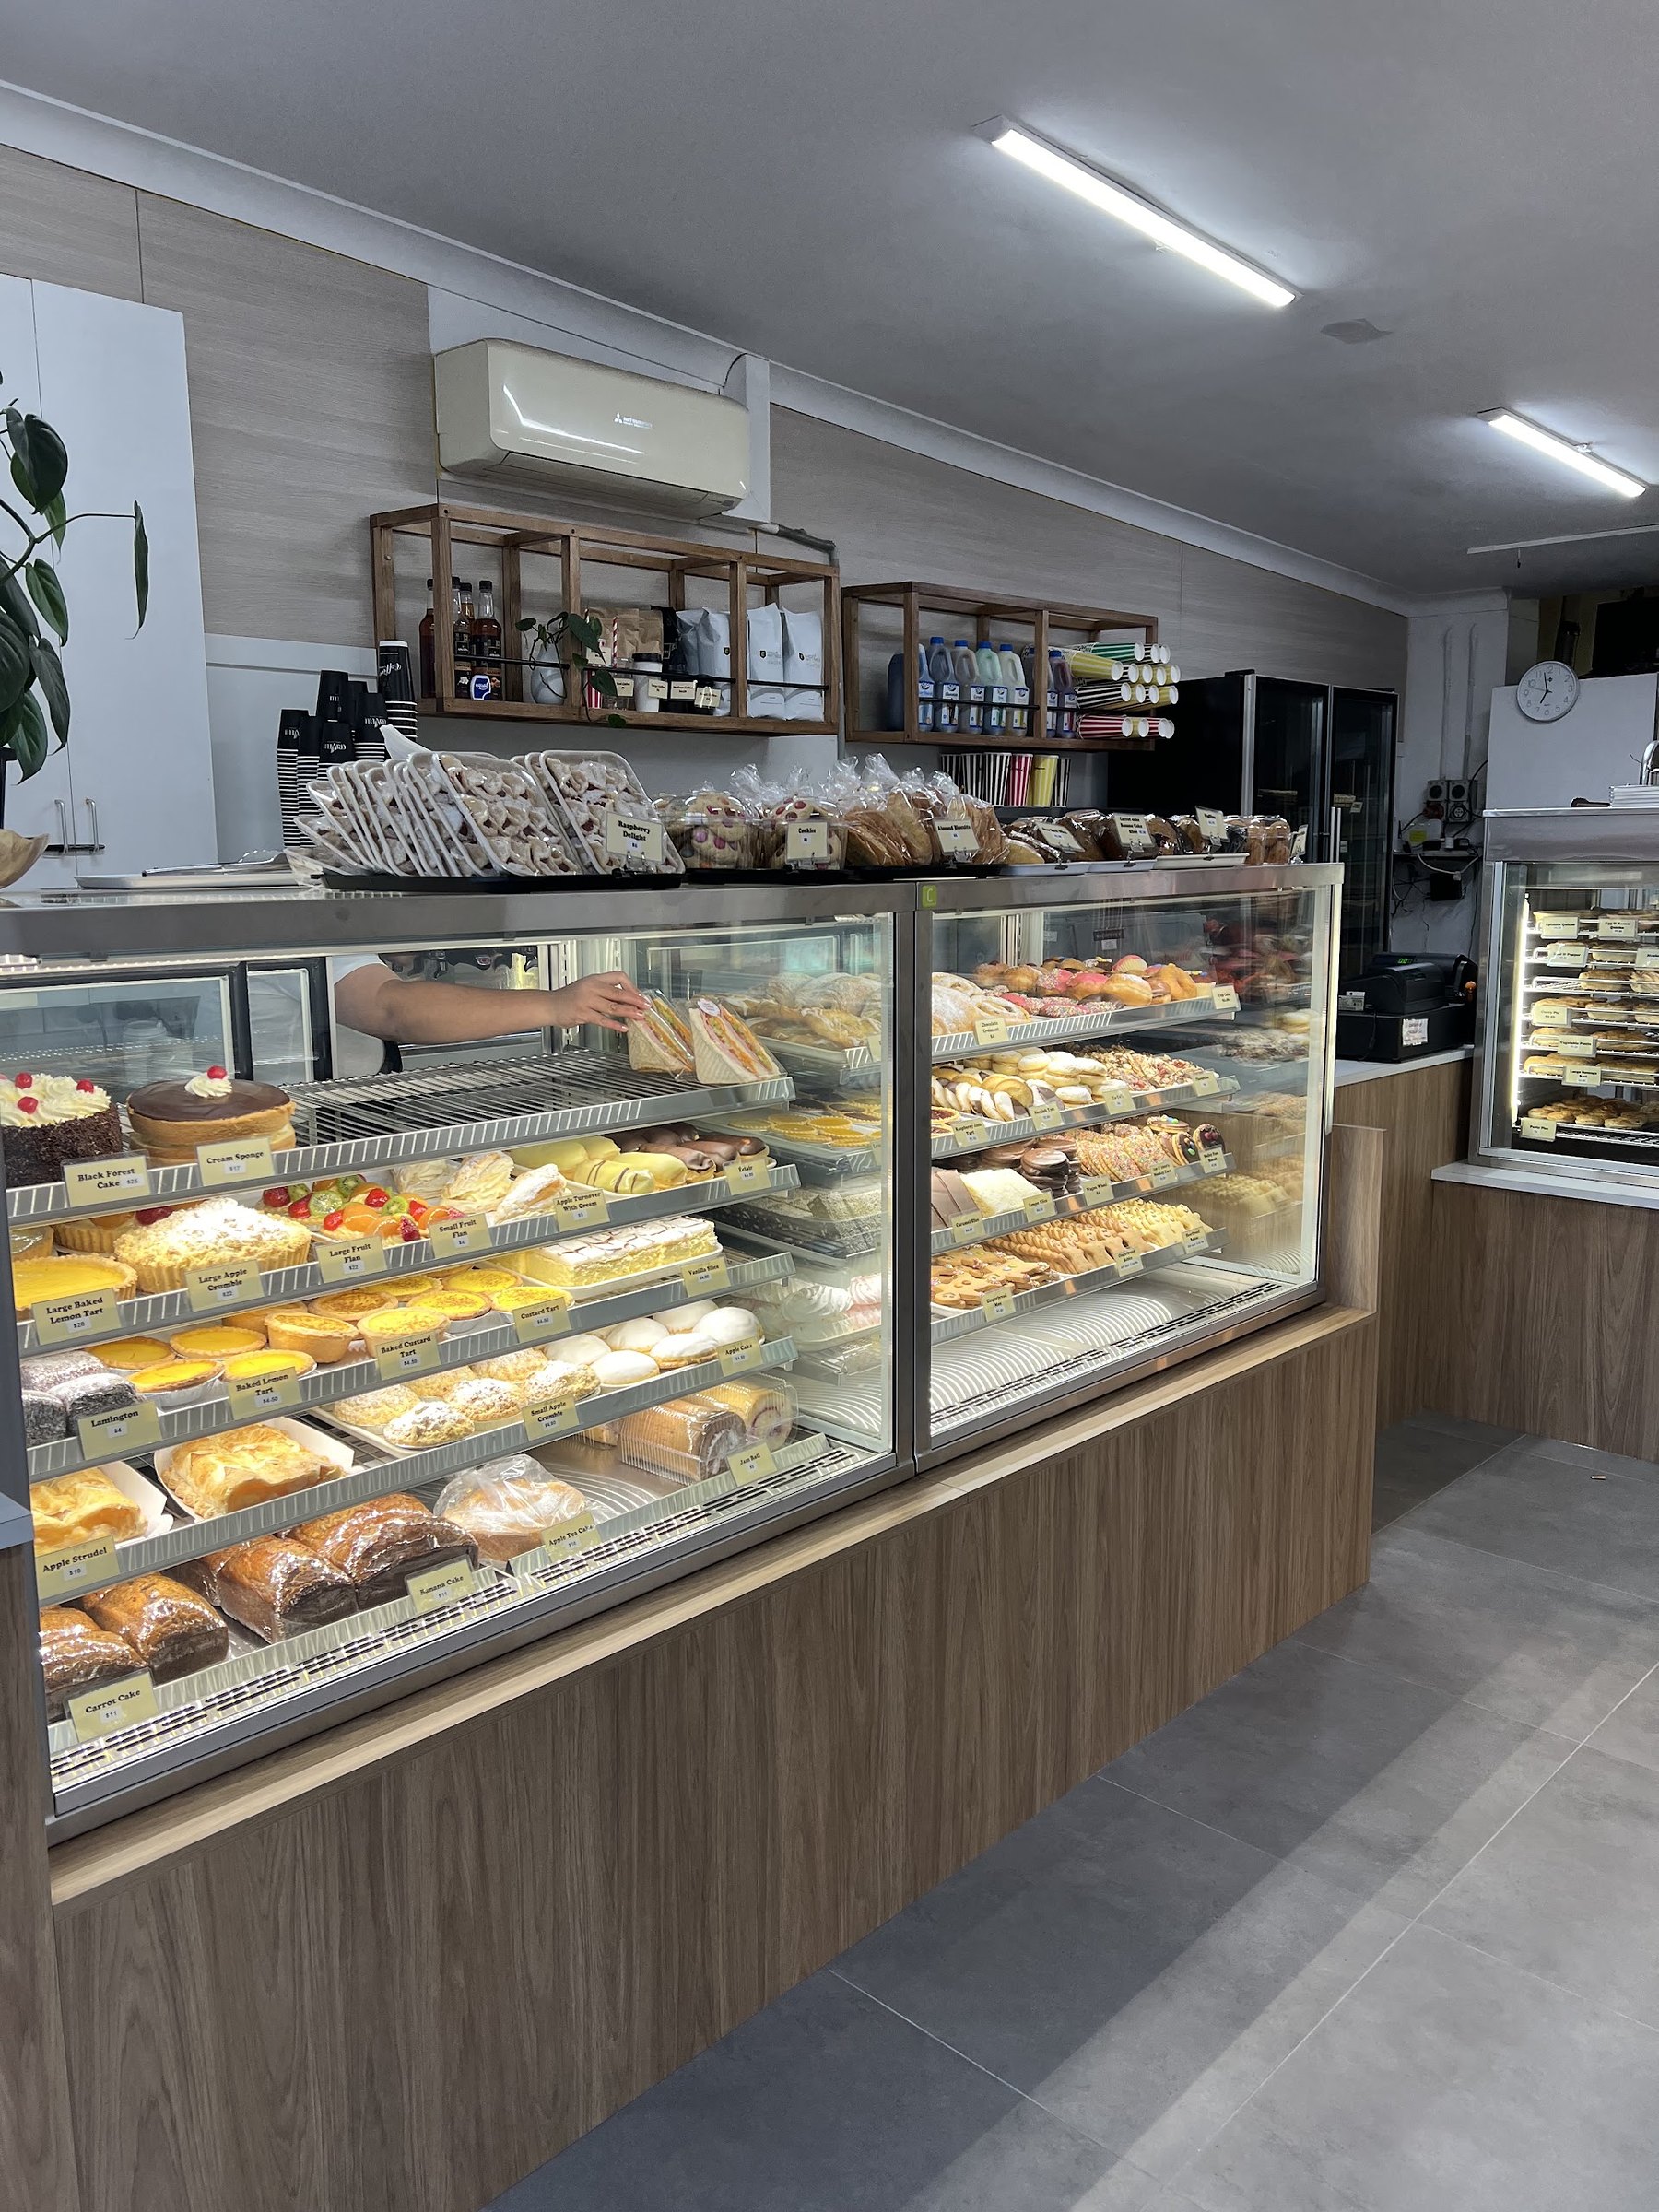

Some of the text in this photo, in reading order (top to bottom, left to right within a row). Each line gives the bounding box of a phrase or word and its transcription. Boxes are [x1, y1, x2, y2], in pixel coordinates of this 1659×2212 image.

[618, 820, 651, 834] Raspberry
[623, 830, 646, 841] Delight
[206, 1150, 265, 1165] Cream Sponge
[77, 1168, 135, 1182] Black Forest
[97, 1181, 121, 1190] Cake
[556, 1191, 601, 1206] Apple Turnover
[562, 1200, 598, 1212] With Cream
[439, 1219, 477, 1232] Small Fruit
[452, 1230, 468, 1239] Flan
[329, 1243, 371, 1257] Large Fruit
[344, 1254, 361, 1264] Flan
[198, 1266, 248, 1285] Large Apple
[688, 1266, 707, 1276] Vanilla
[207, 1277, 243, 1291] Crumble
[46, 1296, 104, 1315] Large Baked
[521, 1304, 559, 1320] Custard Tart
[49, 1307, 105, 1324] Lemon Tart
[73, 1321, 86, 1329] $20
[381, 1335, 431, 1354] Baked Custard
[725, 1347, 740, 1355] Apple
[400, 1348, 417, 1358] Tart
[236, 1373, 289, 1393] Baked Lemon
[255, 1386, 274, 1397] Tart
[531, 1400, 568, 1418] Small Apple
[90, 1408, 139, 1428] Lamington
[537, 1410, 564, 1423] Crumble
[740, 1457, 750, 1465] Jam
[547, 1535, 568, 1547] Apple
[567, 1530, 579, 1540] Tea
[42, 1547, 108, 1573] Apple Strudel
[69, 1567, 81, 1576] $10
[419, 1574, 465, 1596] Banana Cake
[84, 1688, 142, 1714] Carrot Cake
[105, 1710, 118, 1719] $11
